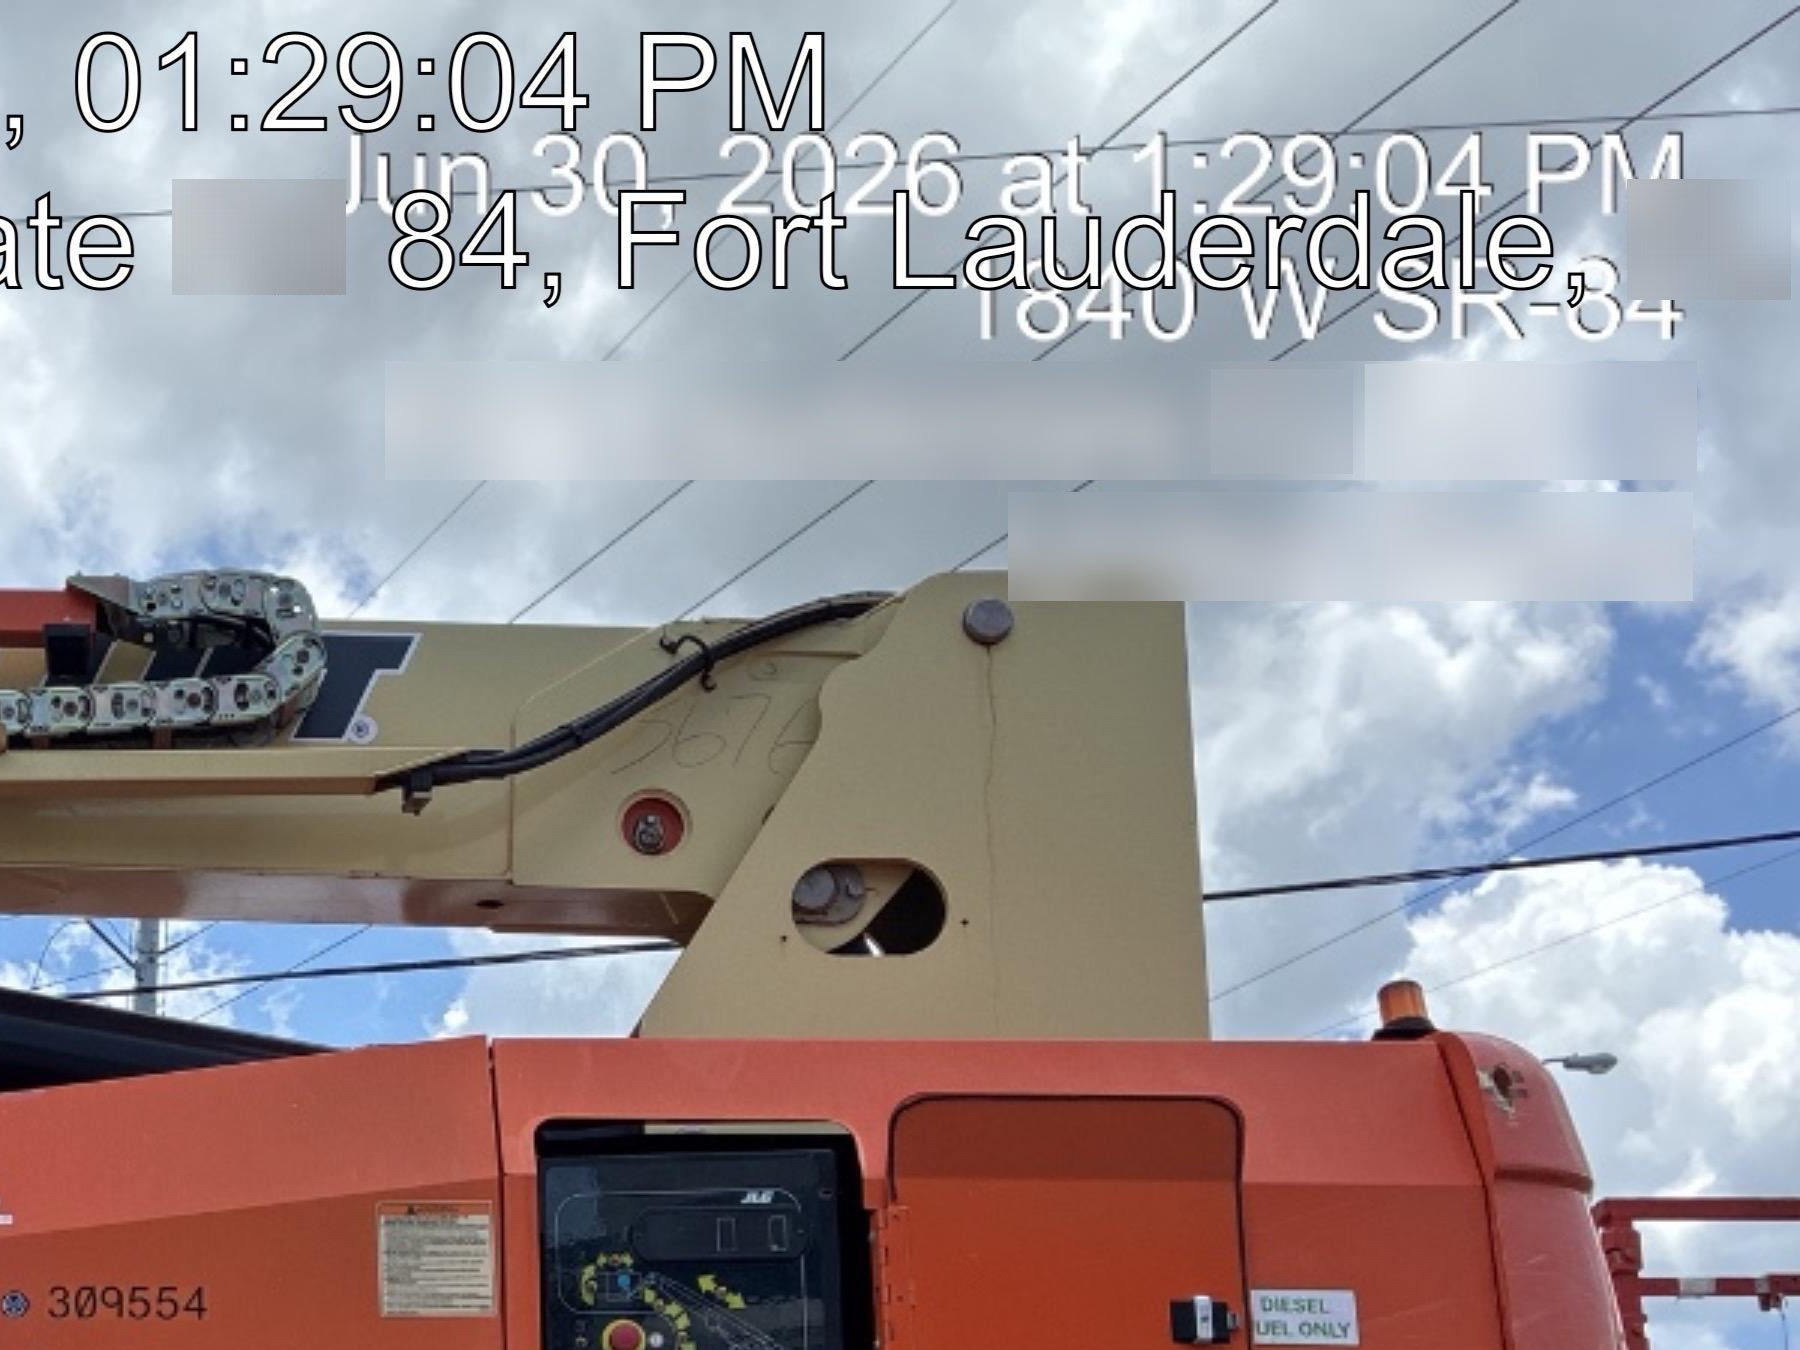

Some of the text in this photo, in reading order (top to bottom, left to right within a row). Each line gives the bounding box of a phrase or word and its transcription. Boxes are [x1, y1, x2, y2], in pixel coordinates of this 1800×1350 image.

[47, 1285, 208, 1321] 309554
[1260, 1295, 1330, 1314] DIESEL
[1255, 1320, 1351, 1339] UEL ONLY
